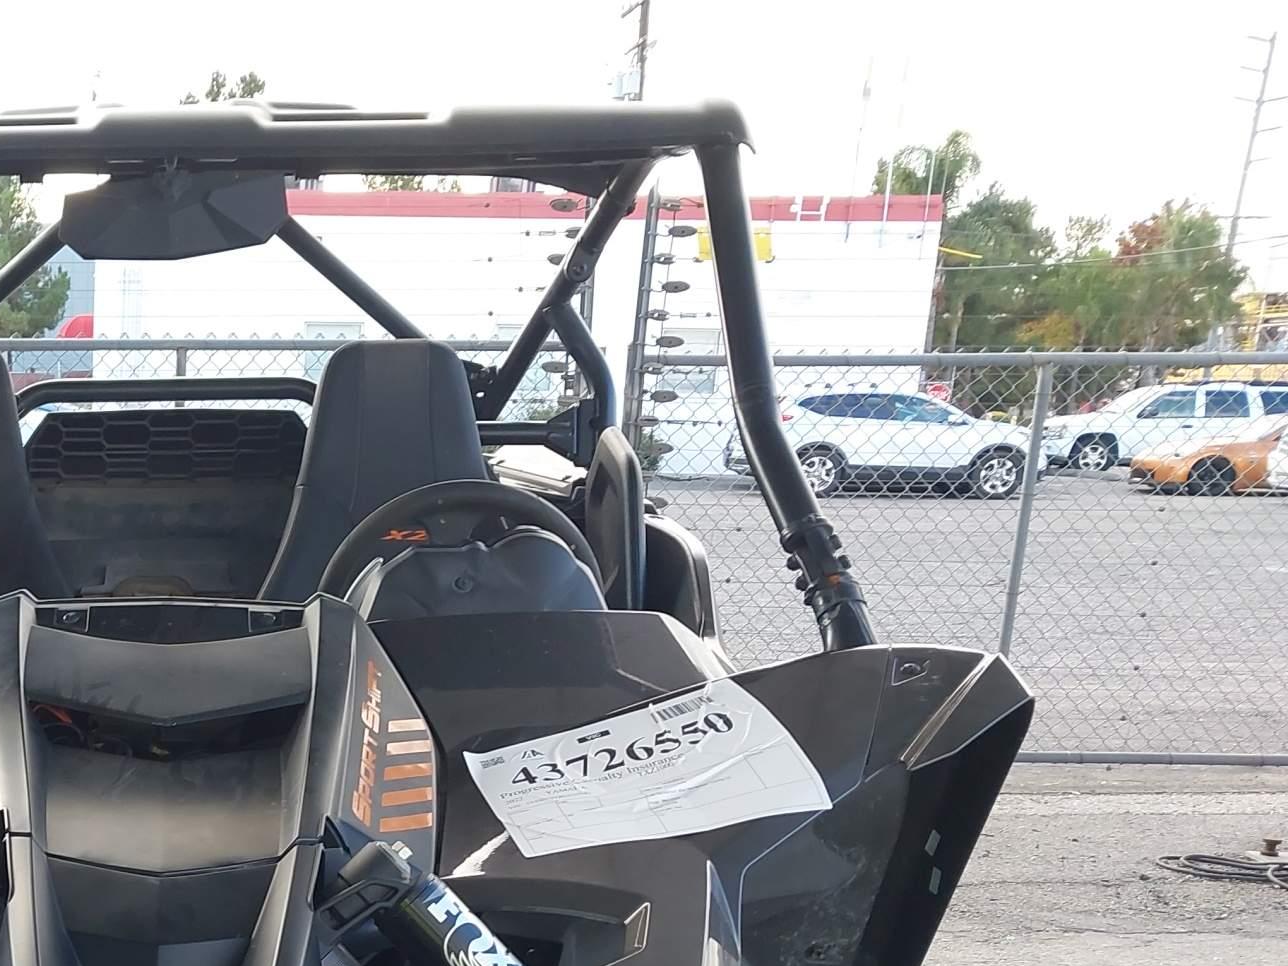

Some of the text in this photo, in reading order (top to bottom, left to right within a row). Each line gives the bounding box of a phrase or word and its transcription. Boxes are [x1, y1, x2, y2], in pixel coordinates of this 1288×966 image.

[351, 728, 380, 828] SPORT
[511, 712, 734, 784] 43726550
[626, 753, 684, 775] Insurance
